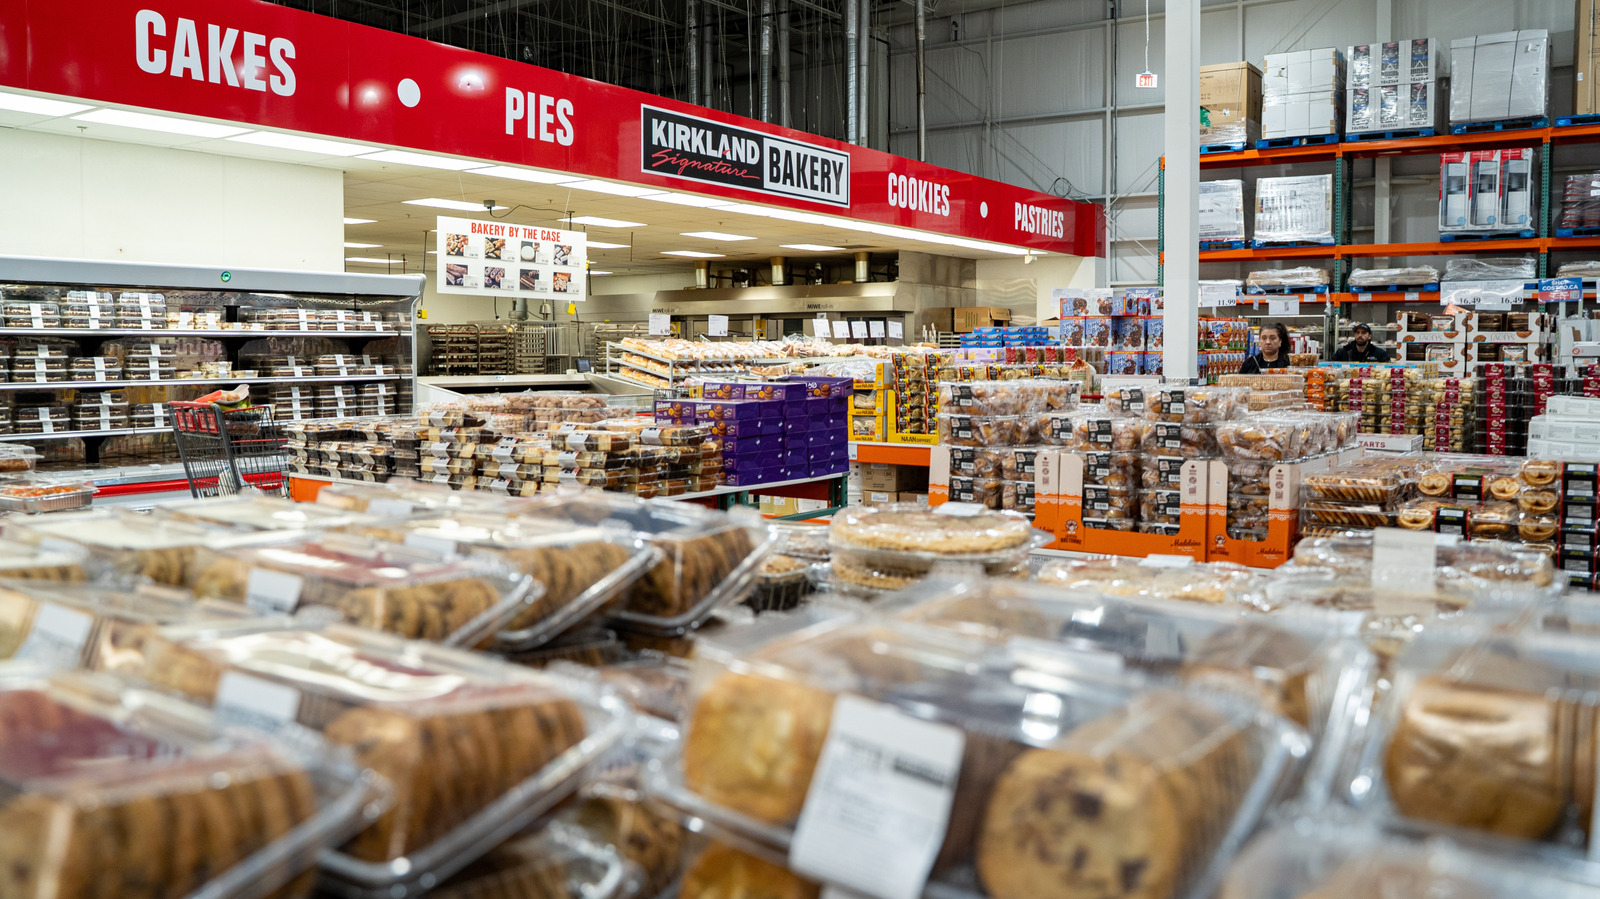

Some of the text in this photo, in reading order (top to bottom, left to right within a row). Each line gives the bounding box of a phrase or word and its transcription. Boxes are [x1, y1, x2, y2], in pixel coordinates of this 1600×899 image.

[135, 9, 296, 97] CAKES
[1139, 75, 1153, 87] EXIT
[505, 87, 574, 147] PIES
[651, 117, 760, 166] KIRKLAND
[651, 148, 760, 181] Signature
[769, 145, 844, 196] BAKERY
[887, 172, 950, 218] COOKIES
[471, 222, 561, 243] BAKERY BY THE CASE
[1014, 201, 1064, 240] PASTRIES
[1459, 297, 1482, 305] 16.49
[1500, 296, 1523, 305] 16.49
[1359, 440, 1386, 449] TARTS
[1170, 539, 1202, 547] Madeleine
